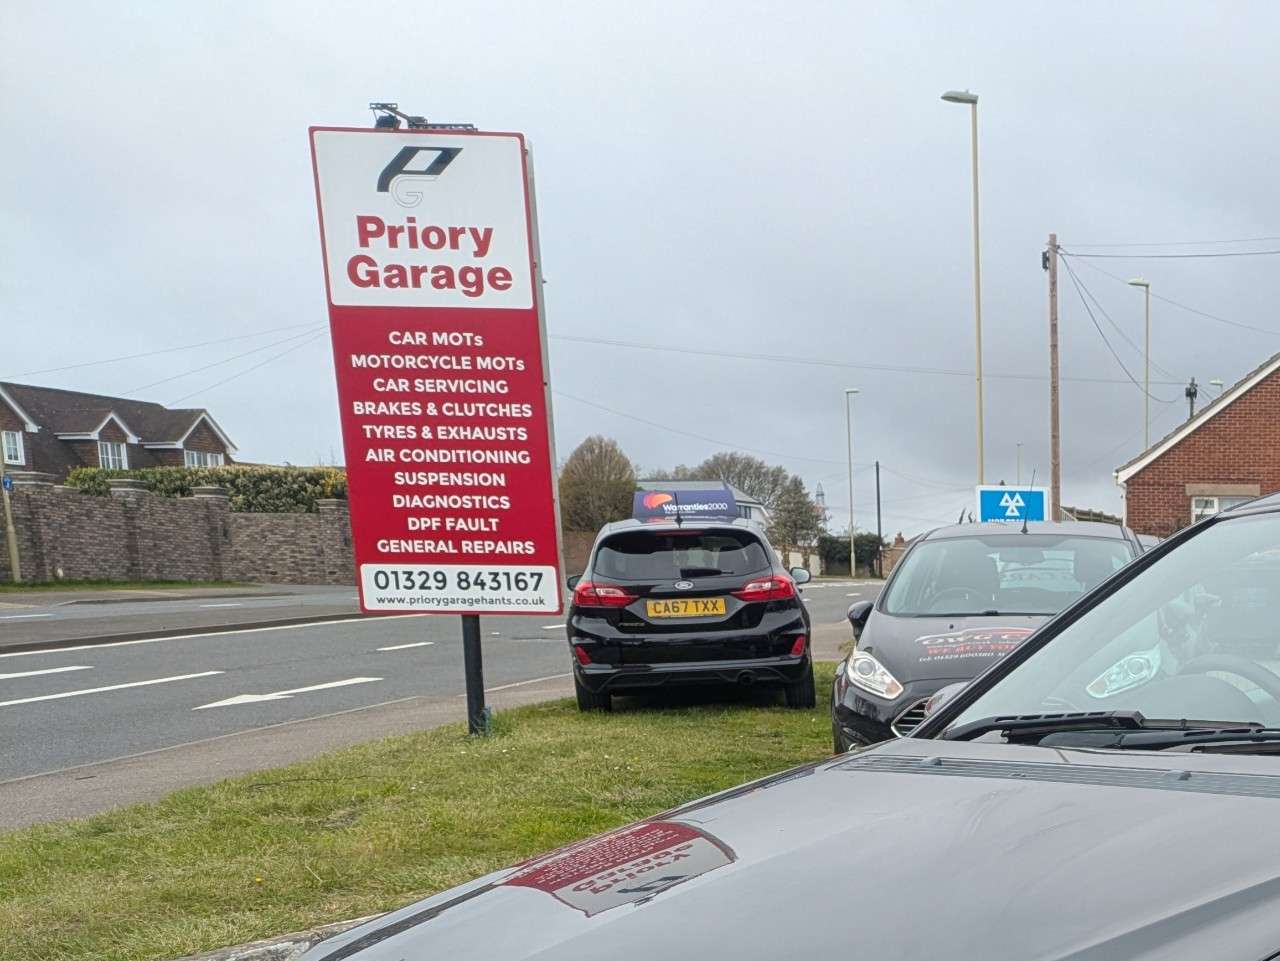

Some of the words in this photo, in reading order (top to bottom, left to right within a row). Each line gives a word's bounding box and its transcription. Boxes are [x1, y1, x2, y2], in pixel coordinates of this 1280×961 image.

[355, 214, 494, 258] Priory
[346, 254, 513, 298] Garage
[388, 331, 428, 346] CAR
[432, 331, 484, 347] MOTs
[351, 354, 472, 370] MOTORCYCLE
[476, 356, 526, 371] MOTs
[373, 378, 410, 392] CAR
[414, 379, 509, 394] SERVICING
[353, 401, 422, 416] BRAKES
[427, 402, 438, 416] &
[442, 402, 533, 417] CLUTCHES
[362, 424, 417, 440] TYRES
[421, 426, 432, 440] &
[437, 426, 528, 441] EXHAUSTS
[365, 448, 396, 463] AIR
[399, 449, 531, 464] CONDITIONING
[394, 471, 506, 487] SUSPENSION
[392, 494, 511, 510] DIAGNOSTICS
[407, 518, 442, 532] DPF
[445, 518, 499, 532] FAULT
[377, 539, 458, 554] GENERAL
[461, 540, 535, 555] REPAIRS
[374, 570, 448, 591] 01329
[456, 571, 544, 592] 843167
[375, 595, 546, 607] www.priorygaragehants.co.uk
[653, 600, 689, 614] CA67
[691, 600, 719, 612] TXX
